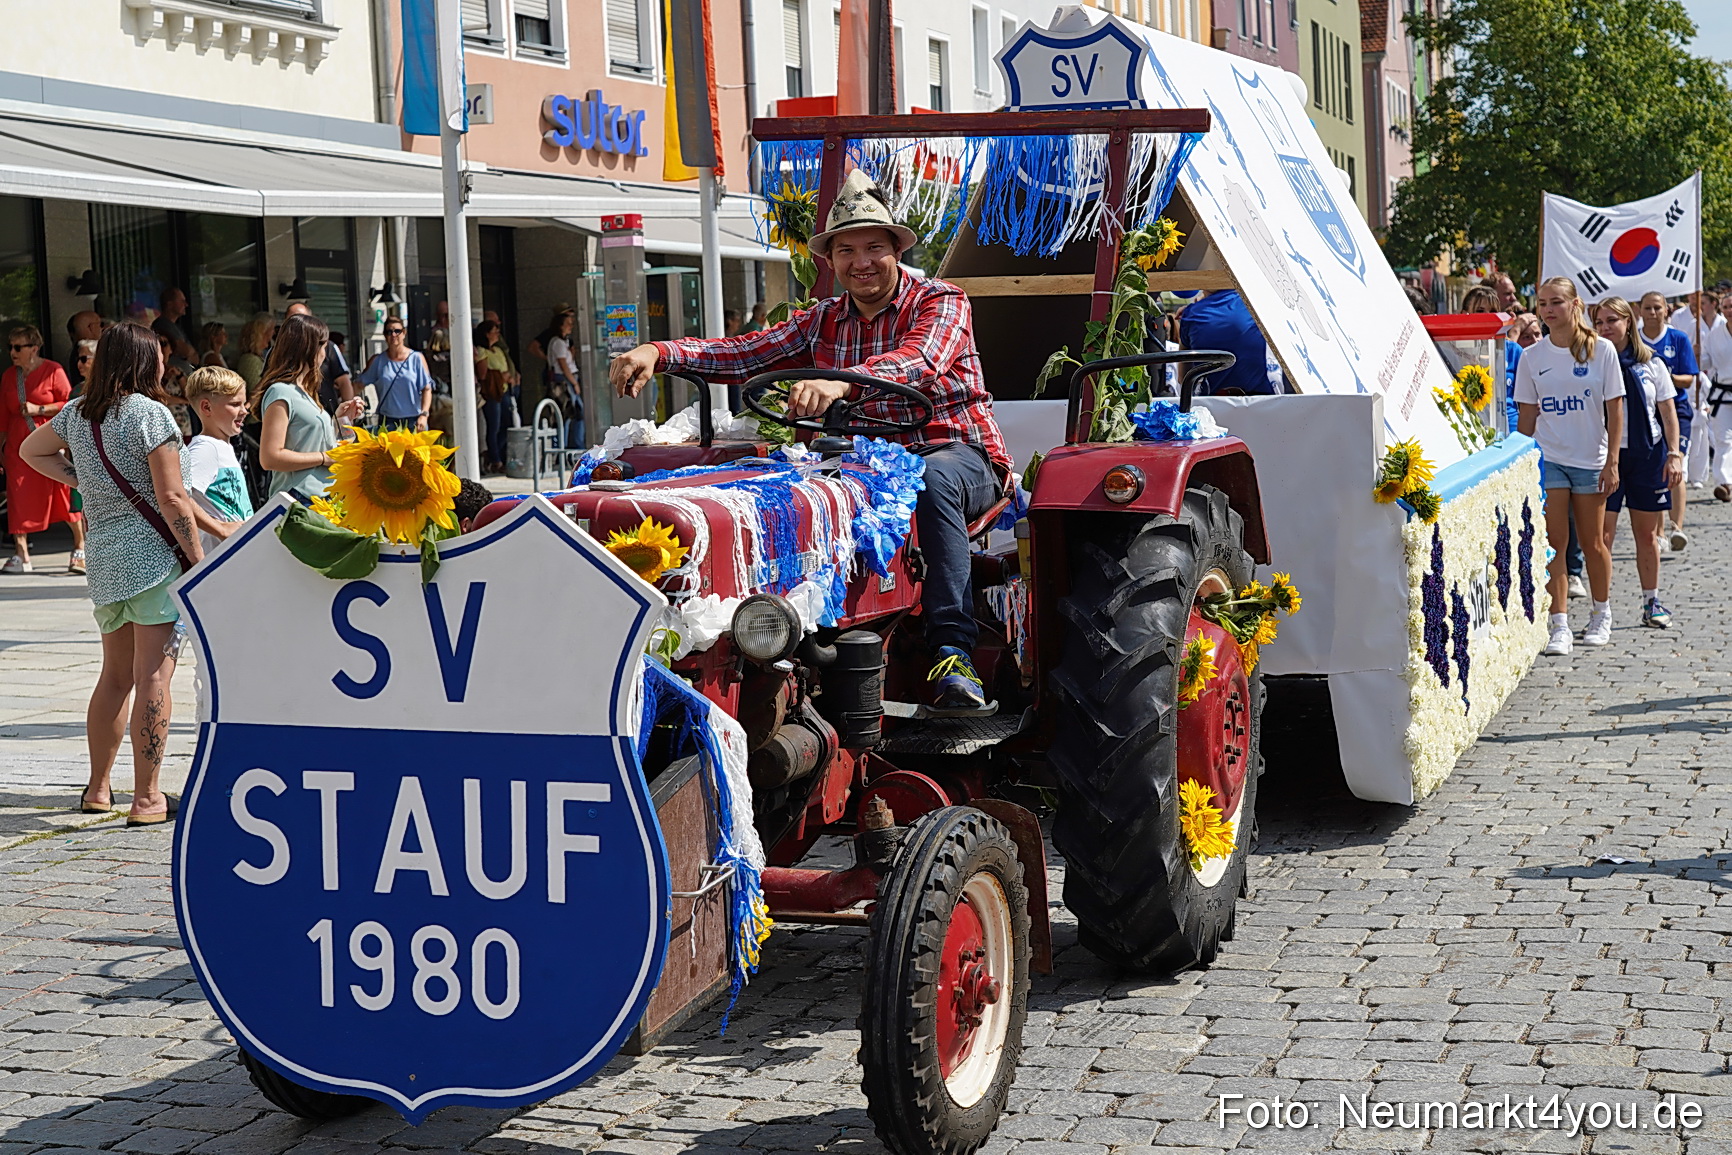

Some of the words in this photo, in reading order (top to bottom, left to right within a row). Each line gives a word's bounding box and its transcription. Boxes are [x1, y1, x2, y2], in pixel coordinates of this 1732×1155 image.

[1051, 53, 1099, 98] SV
[1256, 98, 1290, 147] SV
[1284, 159, 1334, 214] STAUF
[1541, 395, 1585, 416] Elyth
[331, 580, 486, 703] SV
[230, 768, 611, 904] STAUF
[306, 918, 521, 1020] 1980
